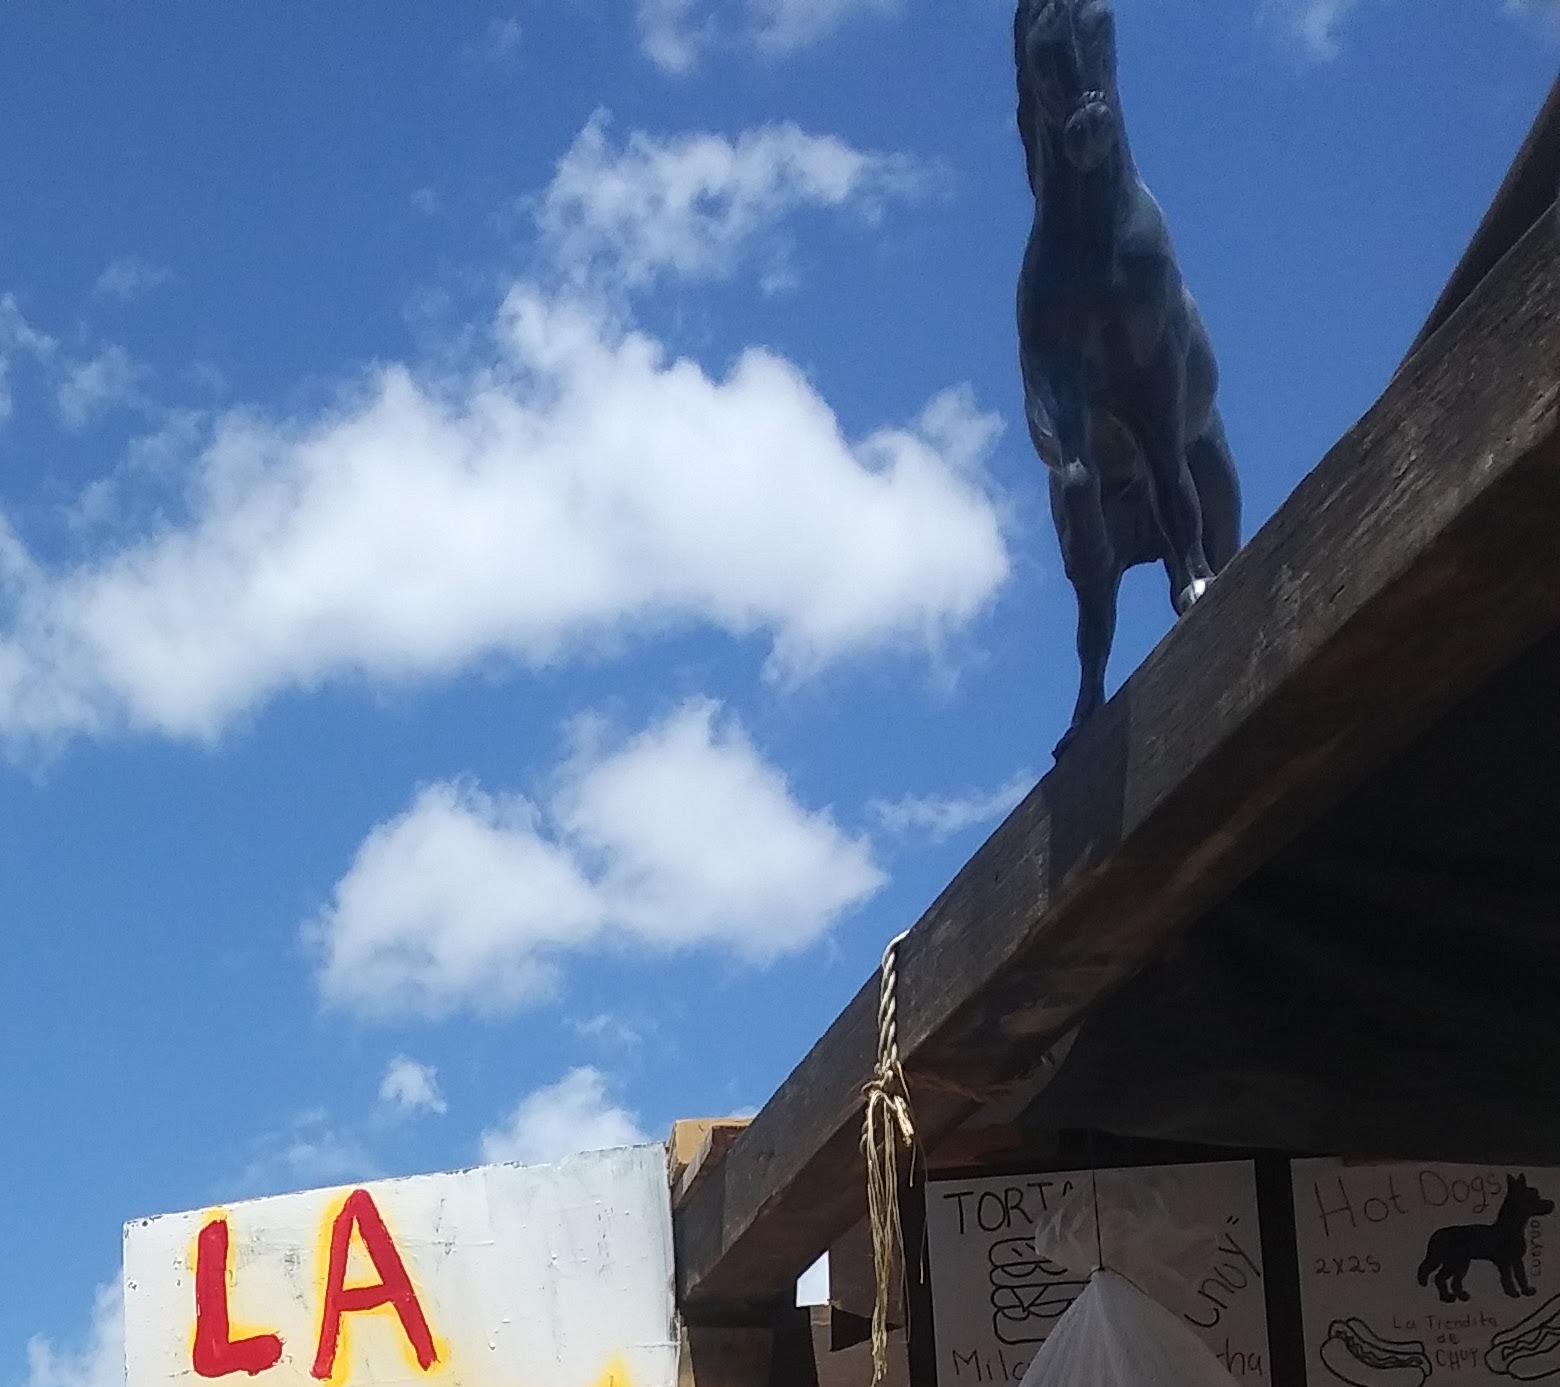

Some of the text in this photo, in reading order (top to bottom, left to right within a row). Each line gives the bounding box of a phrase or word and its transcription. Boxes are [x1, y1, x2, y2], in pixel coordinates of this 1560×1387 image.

[1314, 1170, 1502, 1237] Hot Dogs
[192, 1188, 439, 1381] LA
